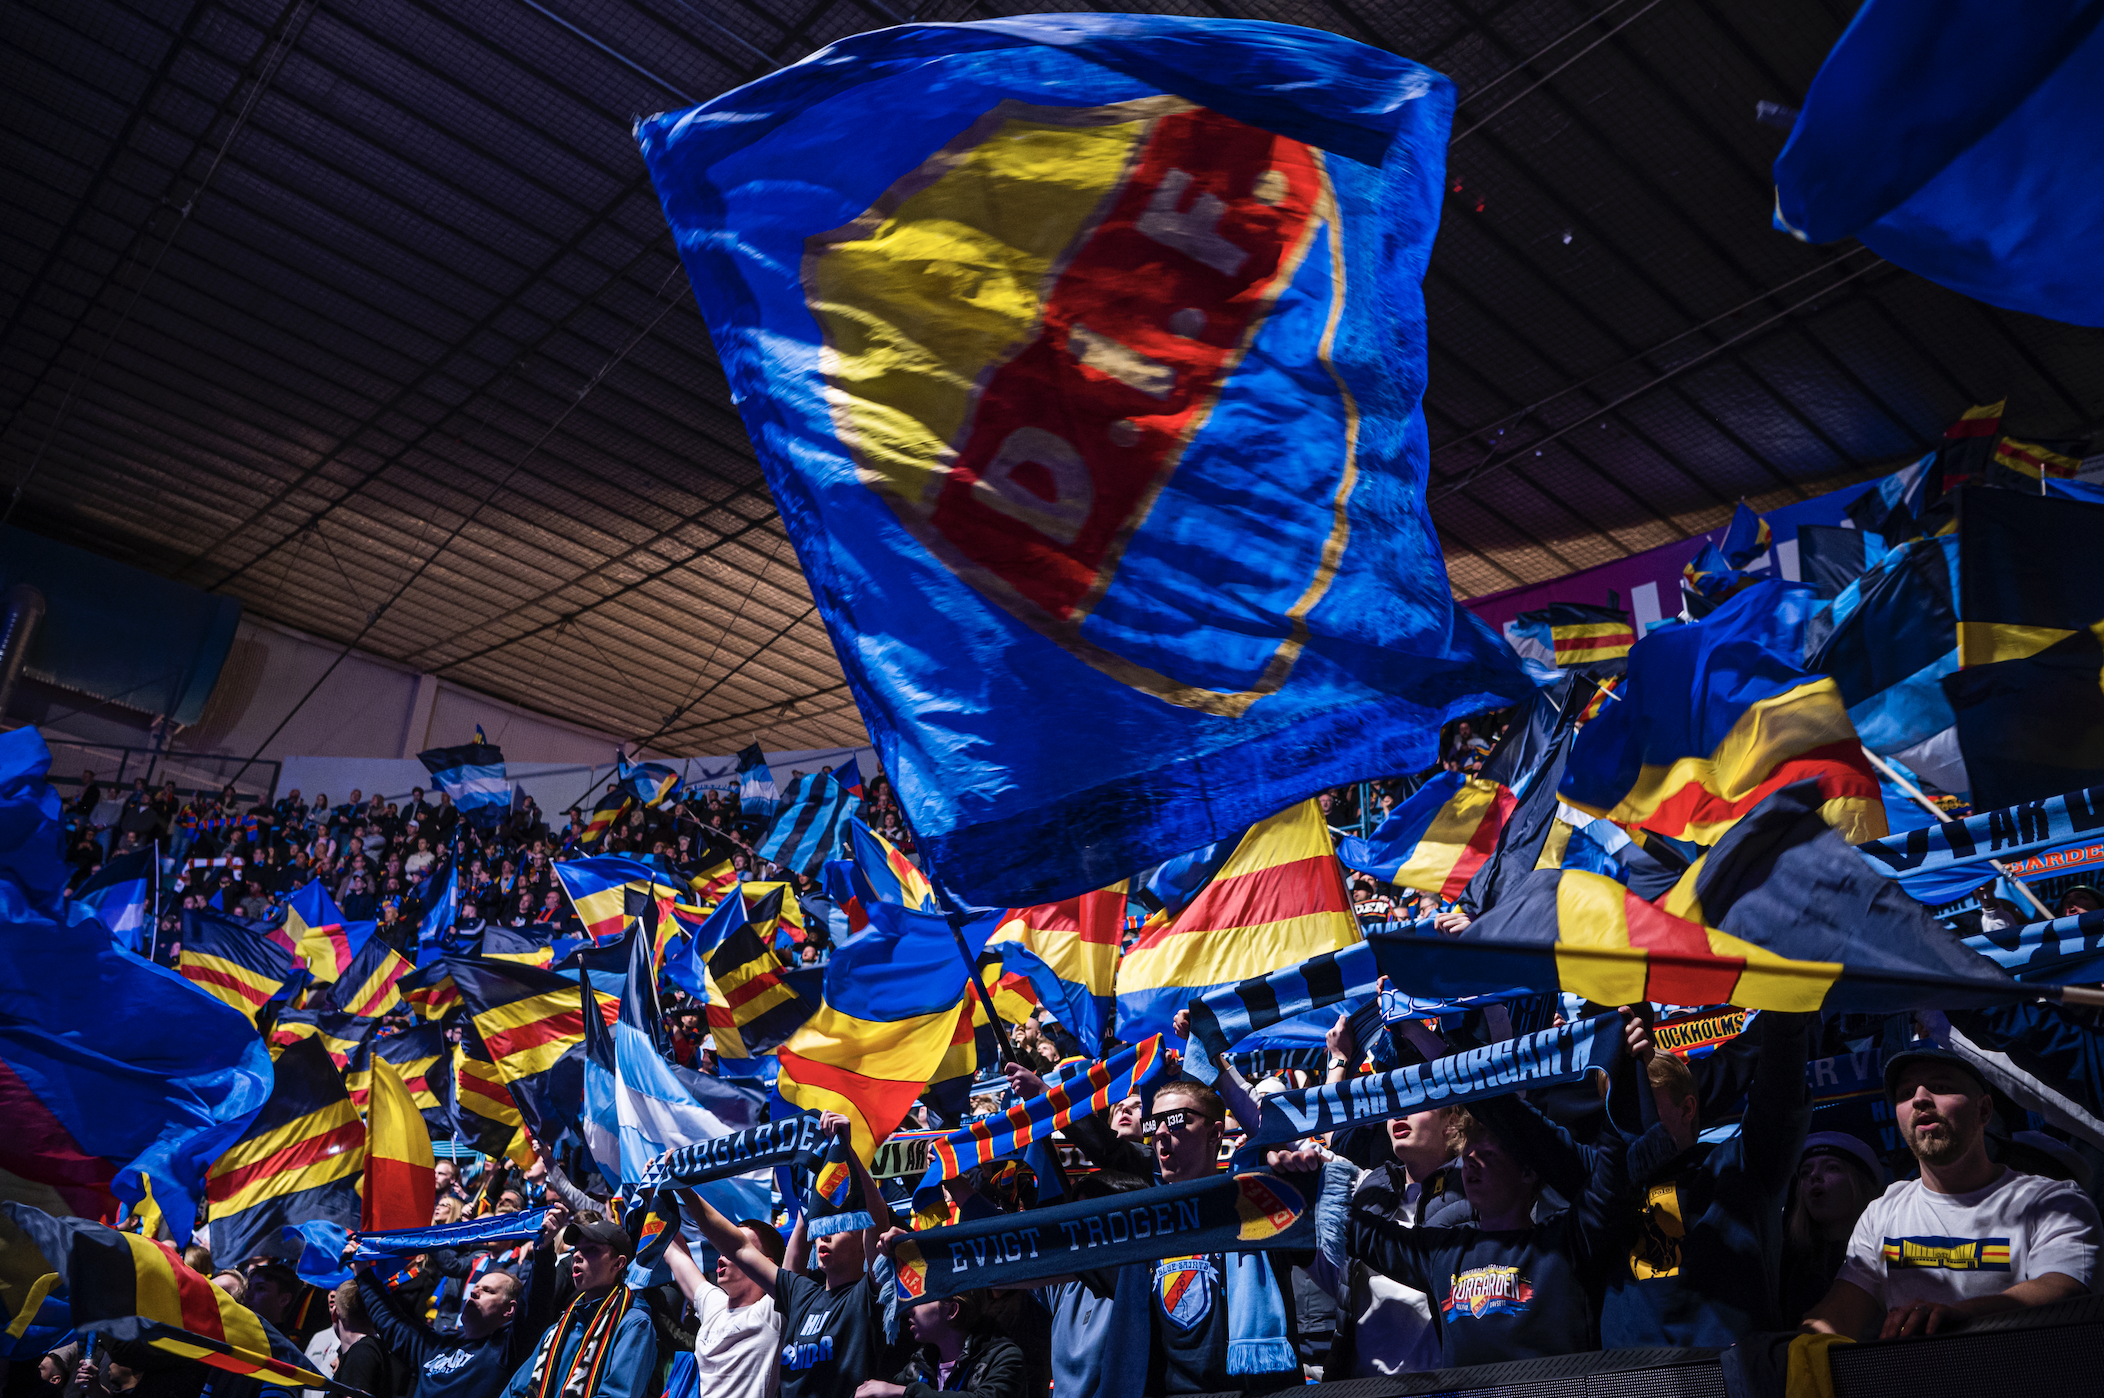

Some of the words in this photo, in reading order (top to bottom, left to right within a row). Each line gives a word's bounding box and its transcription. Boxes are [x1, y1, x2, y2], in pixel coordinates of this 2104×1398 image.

[1653, 1013, 1745, 1049] TOCKHOLMS
[1166, 1112, 1185, 1127] 1312
[949, 1227, 1041, 1274] EVIGT
